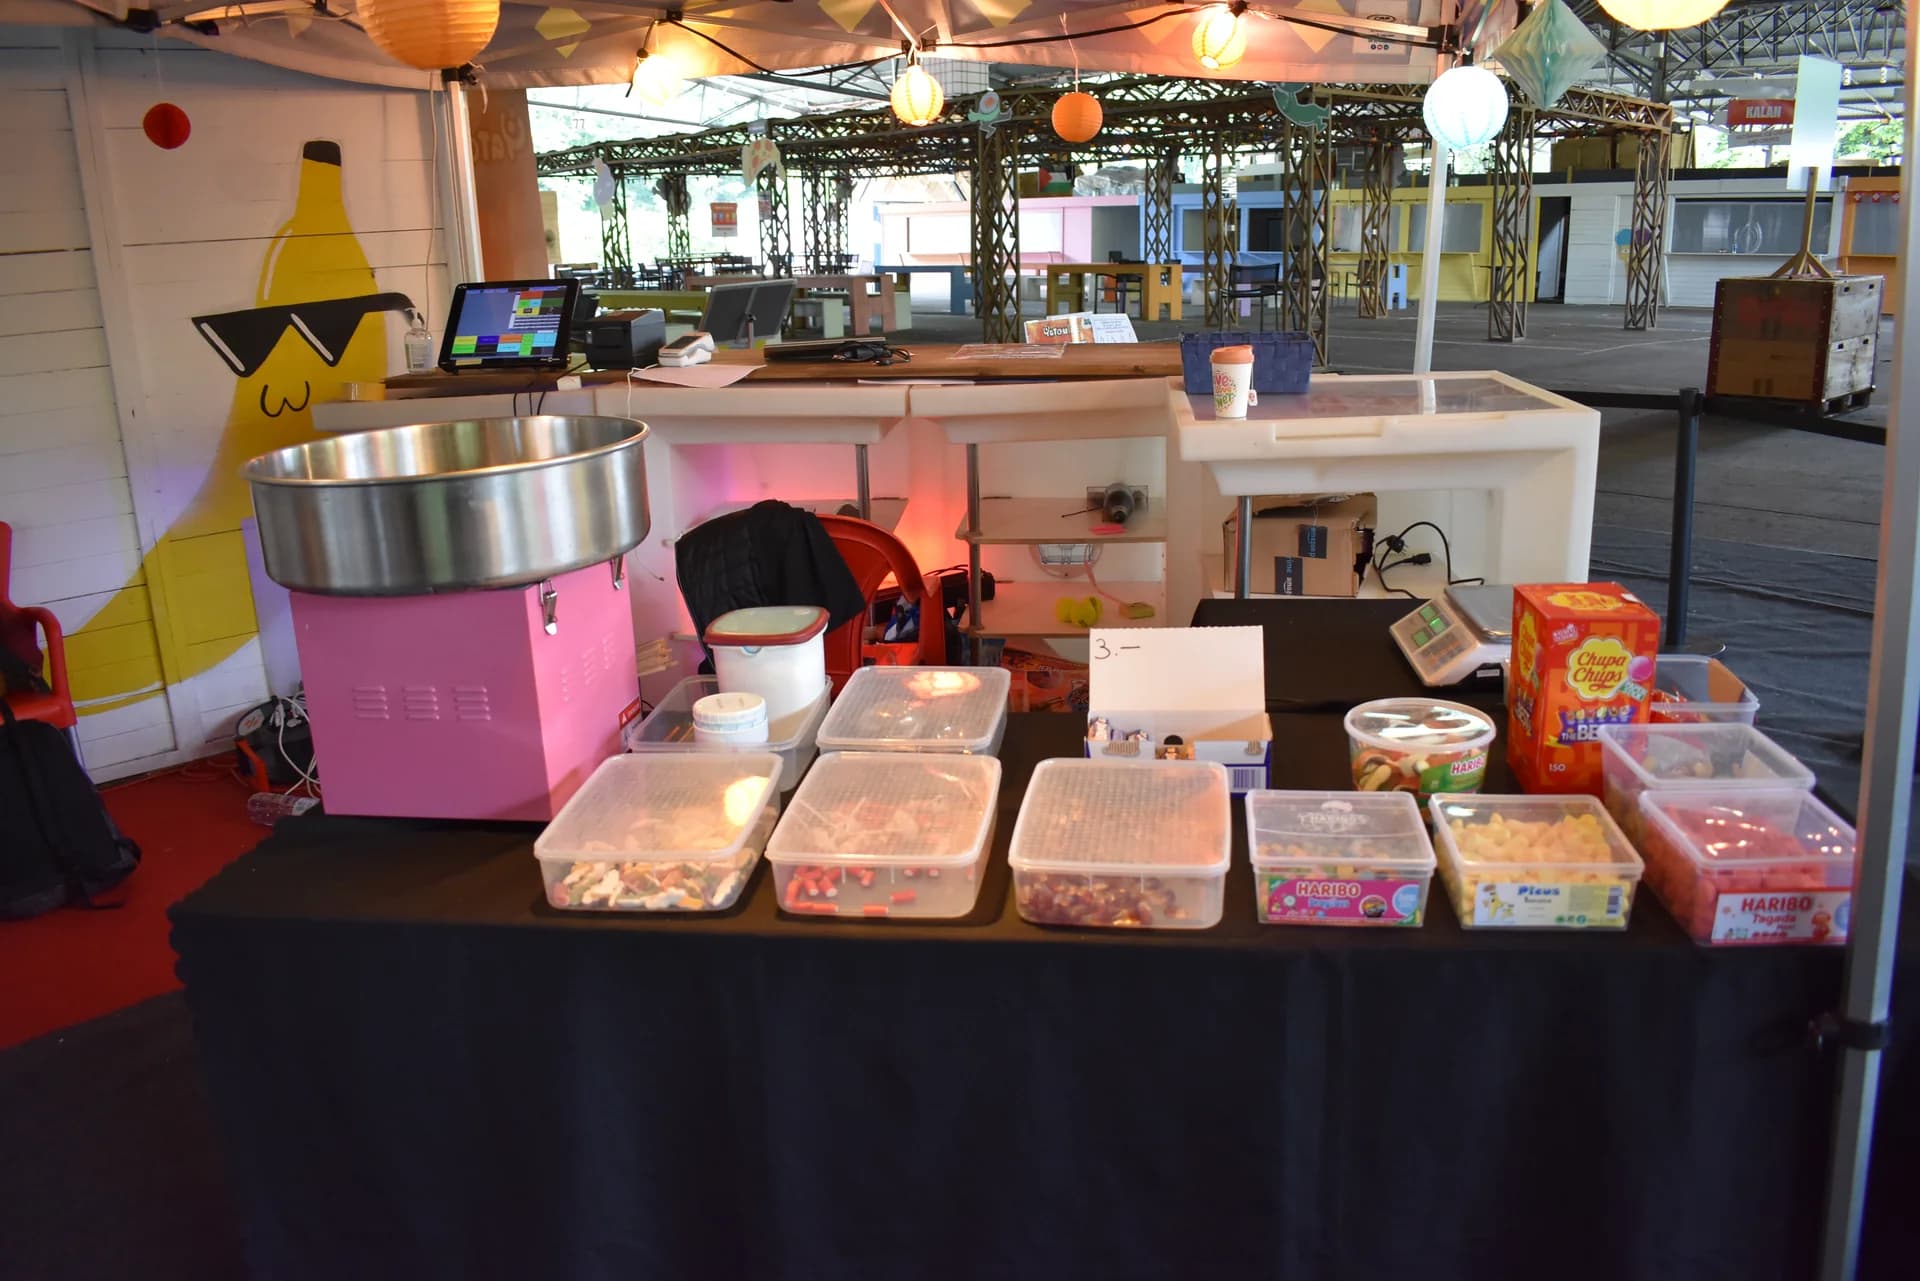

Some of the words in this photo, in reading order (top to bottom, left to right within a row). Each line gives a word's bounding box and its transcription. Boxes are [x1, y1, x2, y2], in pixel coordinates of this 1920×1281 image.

[1577, 651, 1627, 667] Chupa
[1573, 667, 1624, 692] Chups
[1549, 763, 1566, 772] 150
[1296, 882, 1361, 897] HARIBO
[1741, 896, 1813, 912] HARIBO
[1752, 913, 1797, 925] Tagada
